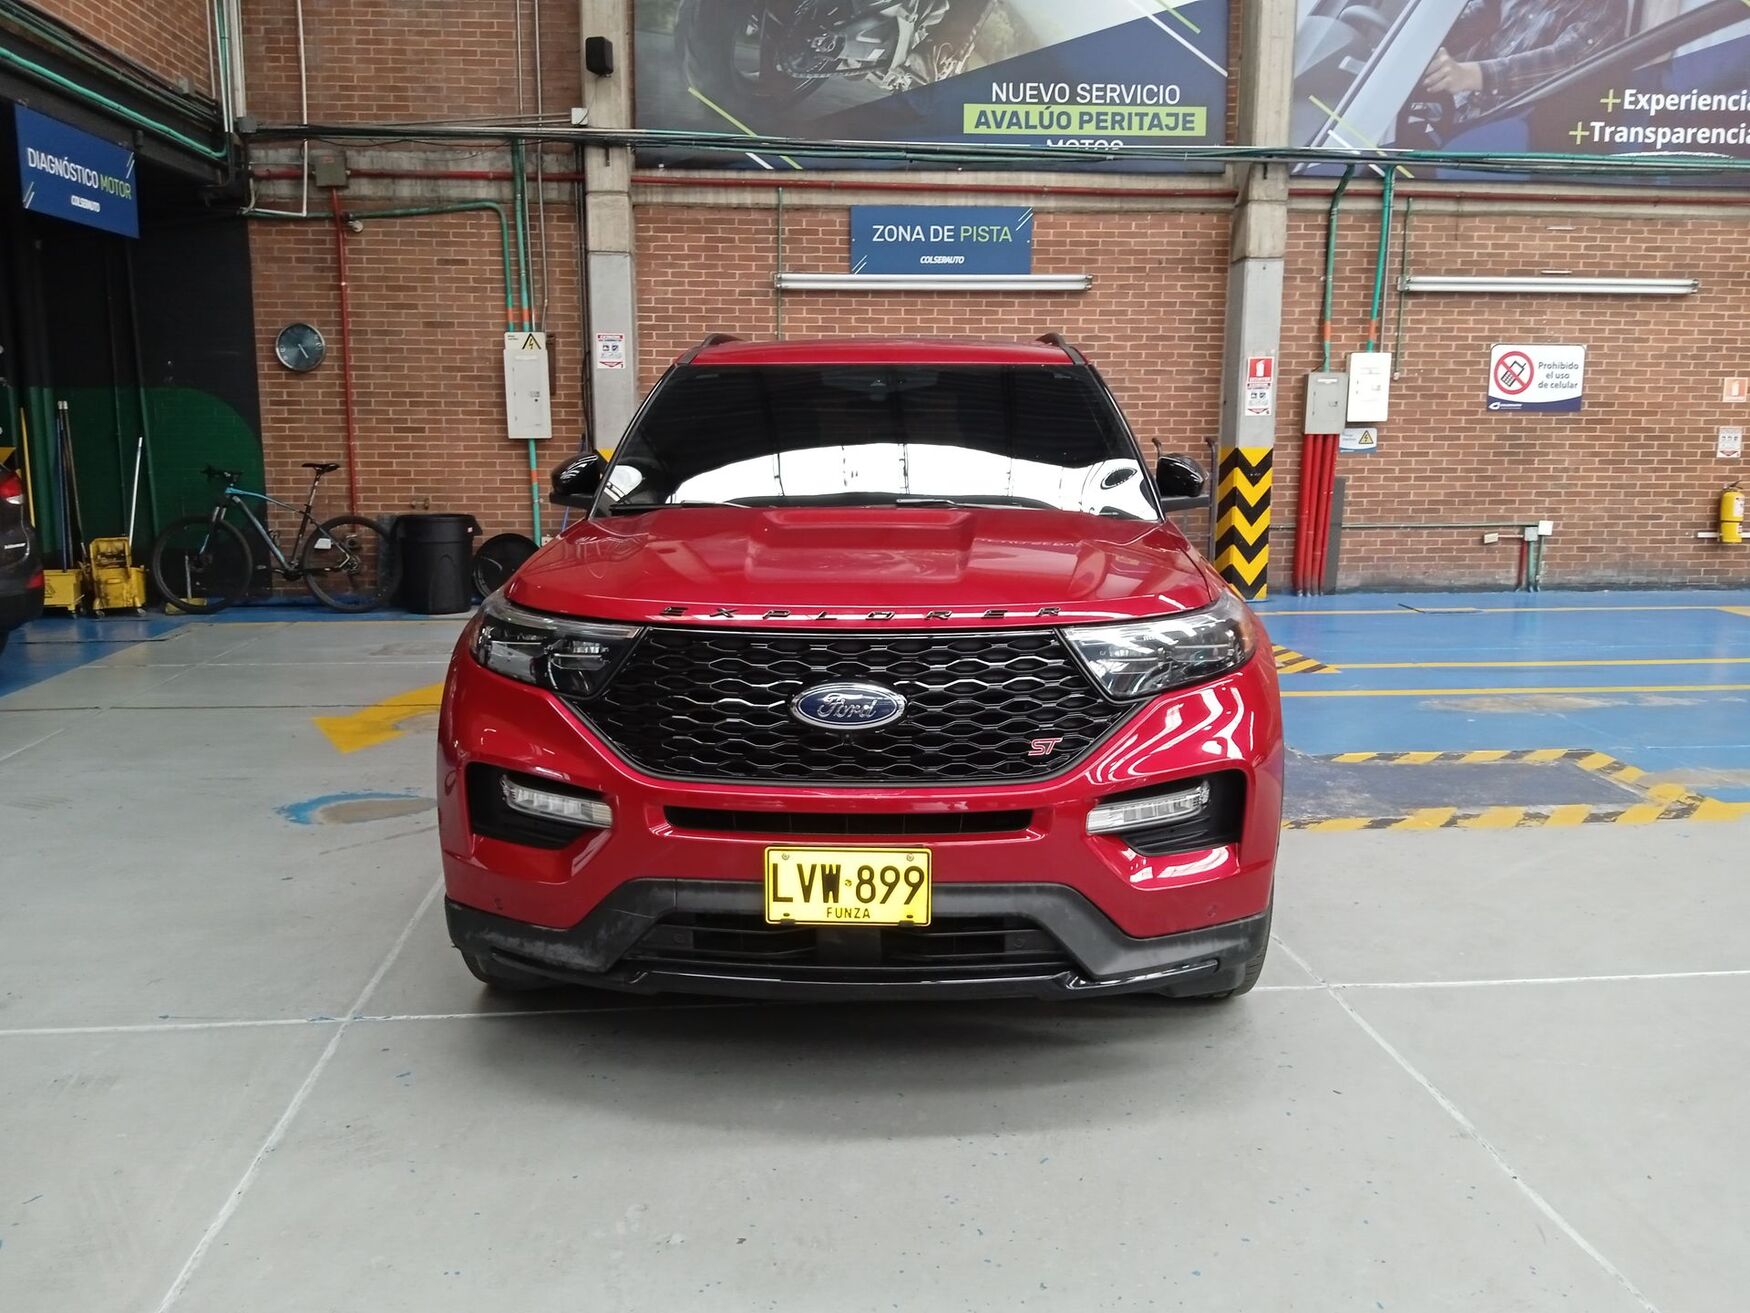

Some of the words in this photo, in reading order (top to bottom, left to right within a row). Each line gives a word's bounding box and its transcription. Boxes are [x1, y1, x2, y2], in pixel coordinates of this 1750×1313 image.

[992, 82, 1069, 103] NUEVO
[1076, 83, 1180, 104] SERVICIO
[1600, 88, 1750, 116] +Experienci
[974, 106, 1072, 130] AVALÚO
[1078, 111, 1195, 131] PERITAJE
[27, 147, 99, 189] DIAGNÓSTICO
[100, 174, 132, 200] MOTOR
[872, 225, 925, 242] ZONA
[930, 225, 955, 242] DE
[960, 226, 1013, 242] PISTA
[1537, 361, 1579, 370] Prohibido
[1545, 371, 1554, 379] el
[1537, 380, 1549, 389] de
[1550, 380, 1578, 389] celular
[659, 606, 1062, 621] EXPLORER
[817, 692, 877, 718] Ford
[1027, 737, 1063, 756] ST
[772, 863, 841, 904] LVW
[855, 864, 925, 905] 899
[826, 906, 871, 919] FUNZA
